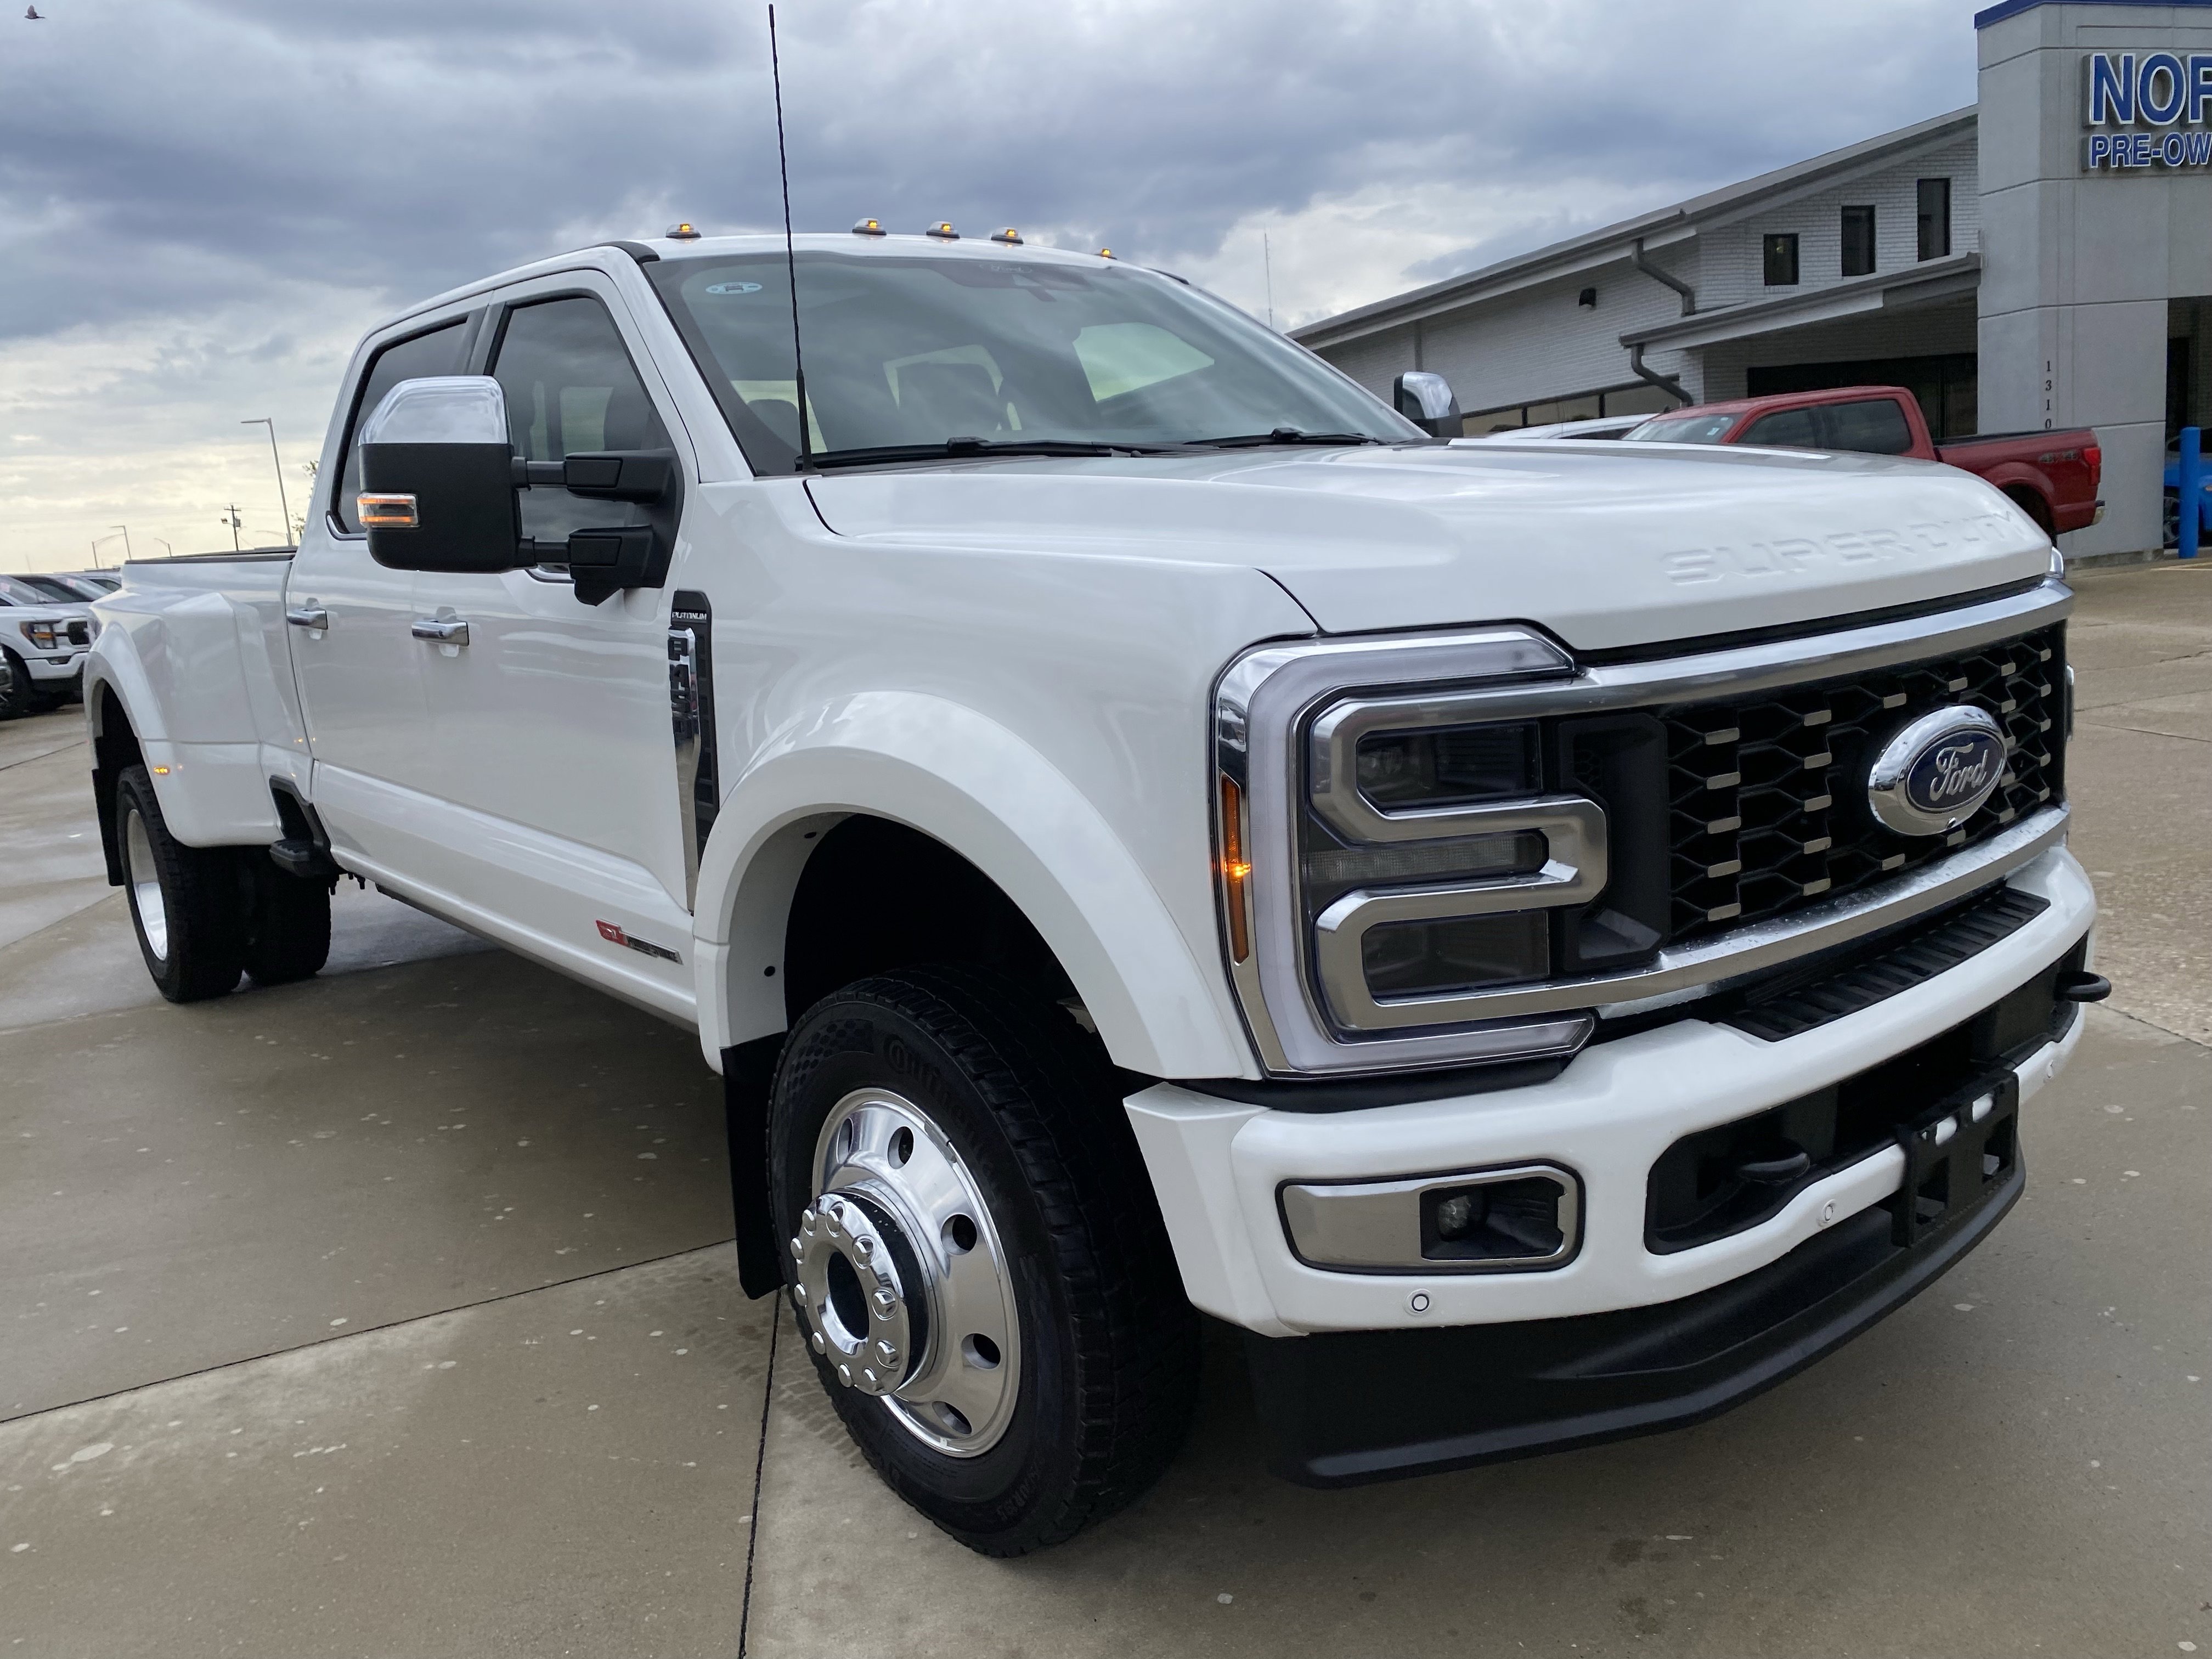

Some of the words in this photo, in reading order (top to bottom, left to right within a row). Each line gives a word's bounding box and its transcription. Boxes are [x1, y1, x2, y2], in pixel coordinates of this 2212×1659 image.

[2089, 132, 2212, 168] PRE-OW
[1660, 528, 1918, 585] SUPER
[672, 611, 707, 620] PLATINUM
[1929, 742, 1989, 802] Ford
